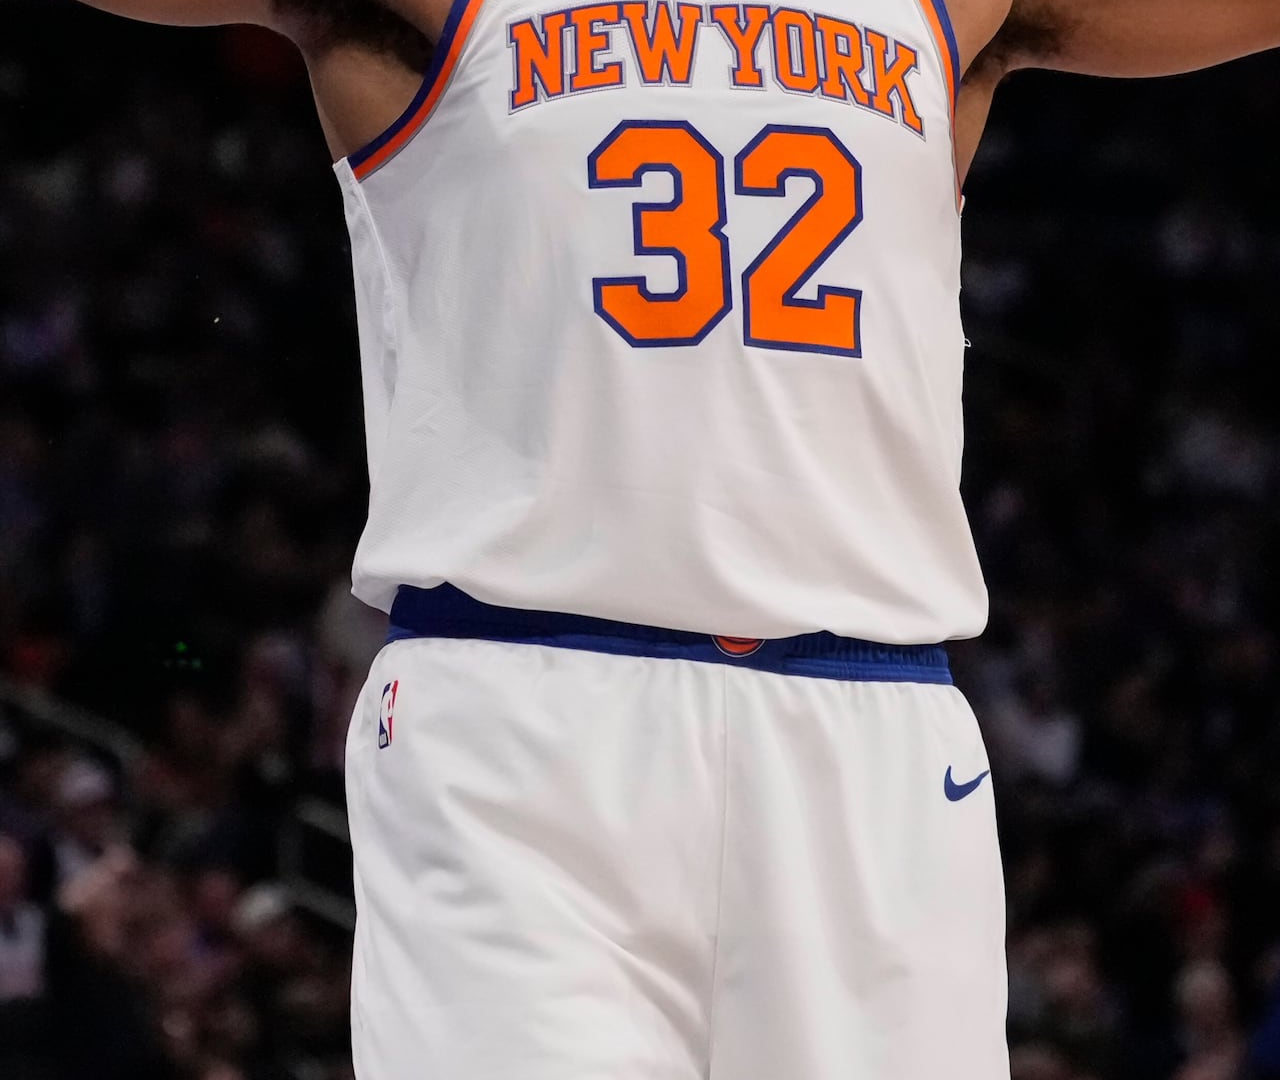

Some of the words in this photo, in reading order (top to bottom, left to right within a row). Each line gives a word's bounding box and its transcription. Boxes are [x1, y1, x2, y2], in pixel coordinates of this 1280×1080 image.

[508, 0, 702, 114] NEW
[710, 3, 925, 141] YORK
[587, 119, 863, 359] 32
